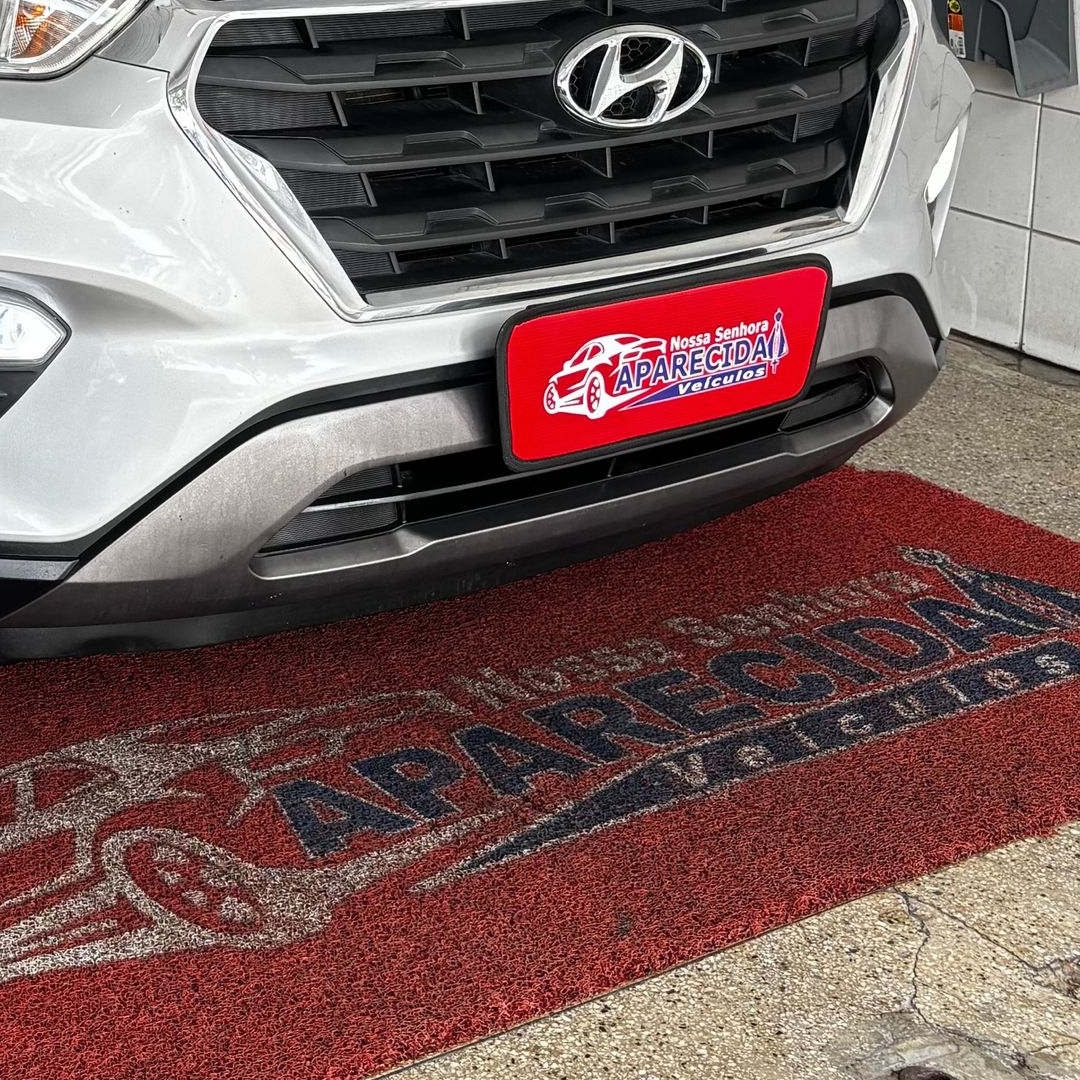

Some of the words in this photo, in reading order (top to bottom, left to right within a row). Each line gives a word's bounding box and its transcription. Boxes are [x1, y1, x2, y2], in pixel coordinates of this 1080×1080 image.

[613, 334, 770, 395] APARECIDA
[670, 332, 711, 352] Nossa
[715, 320, 769, 343] Senhora
[678, 366, 766, 395] Veículos
[450, 636, 684, 712] Nossa
[664, 570, 932, 648] Senhora
[270, 595, 1054, 860] APARECIDA
